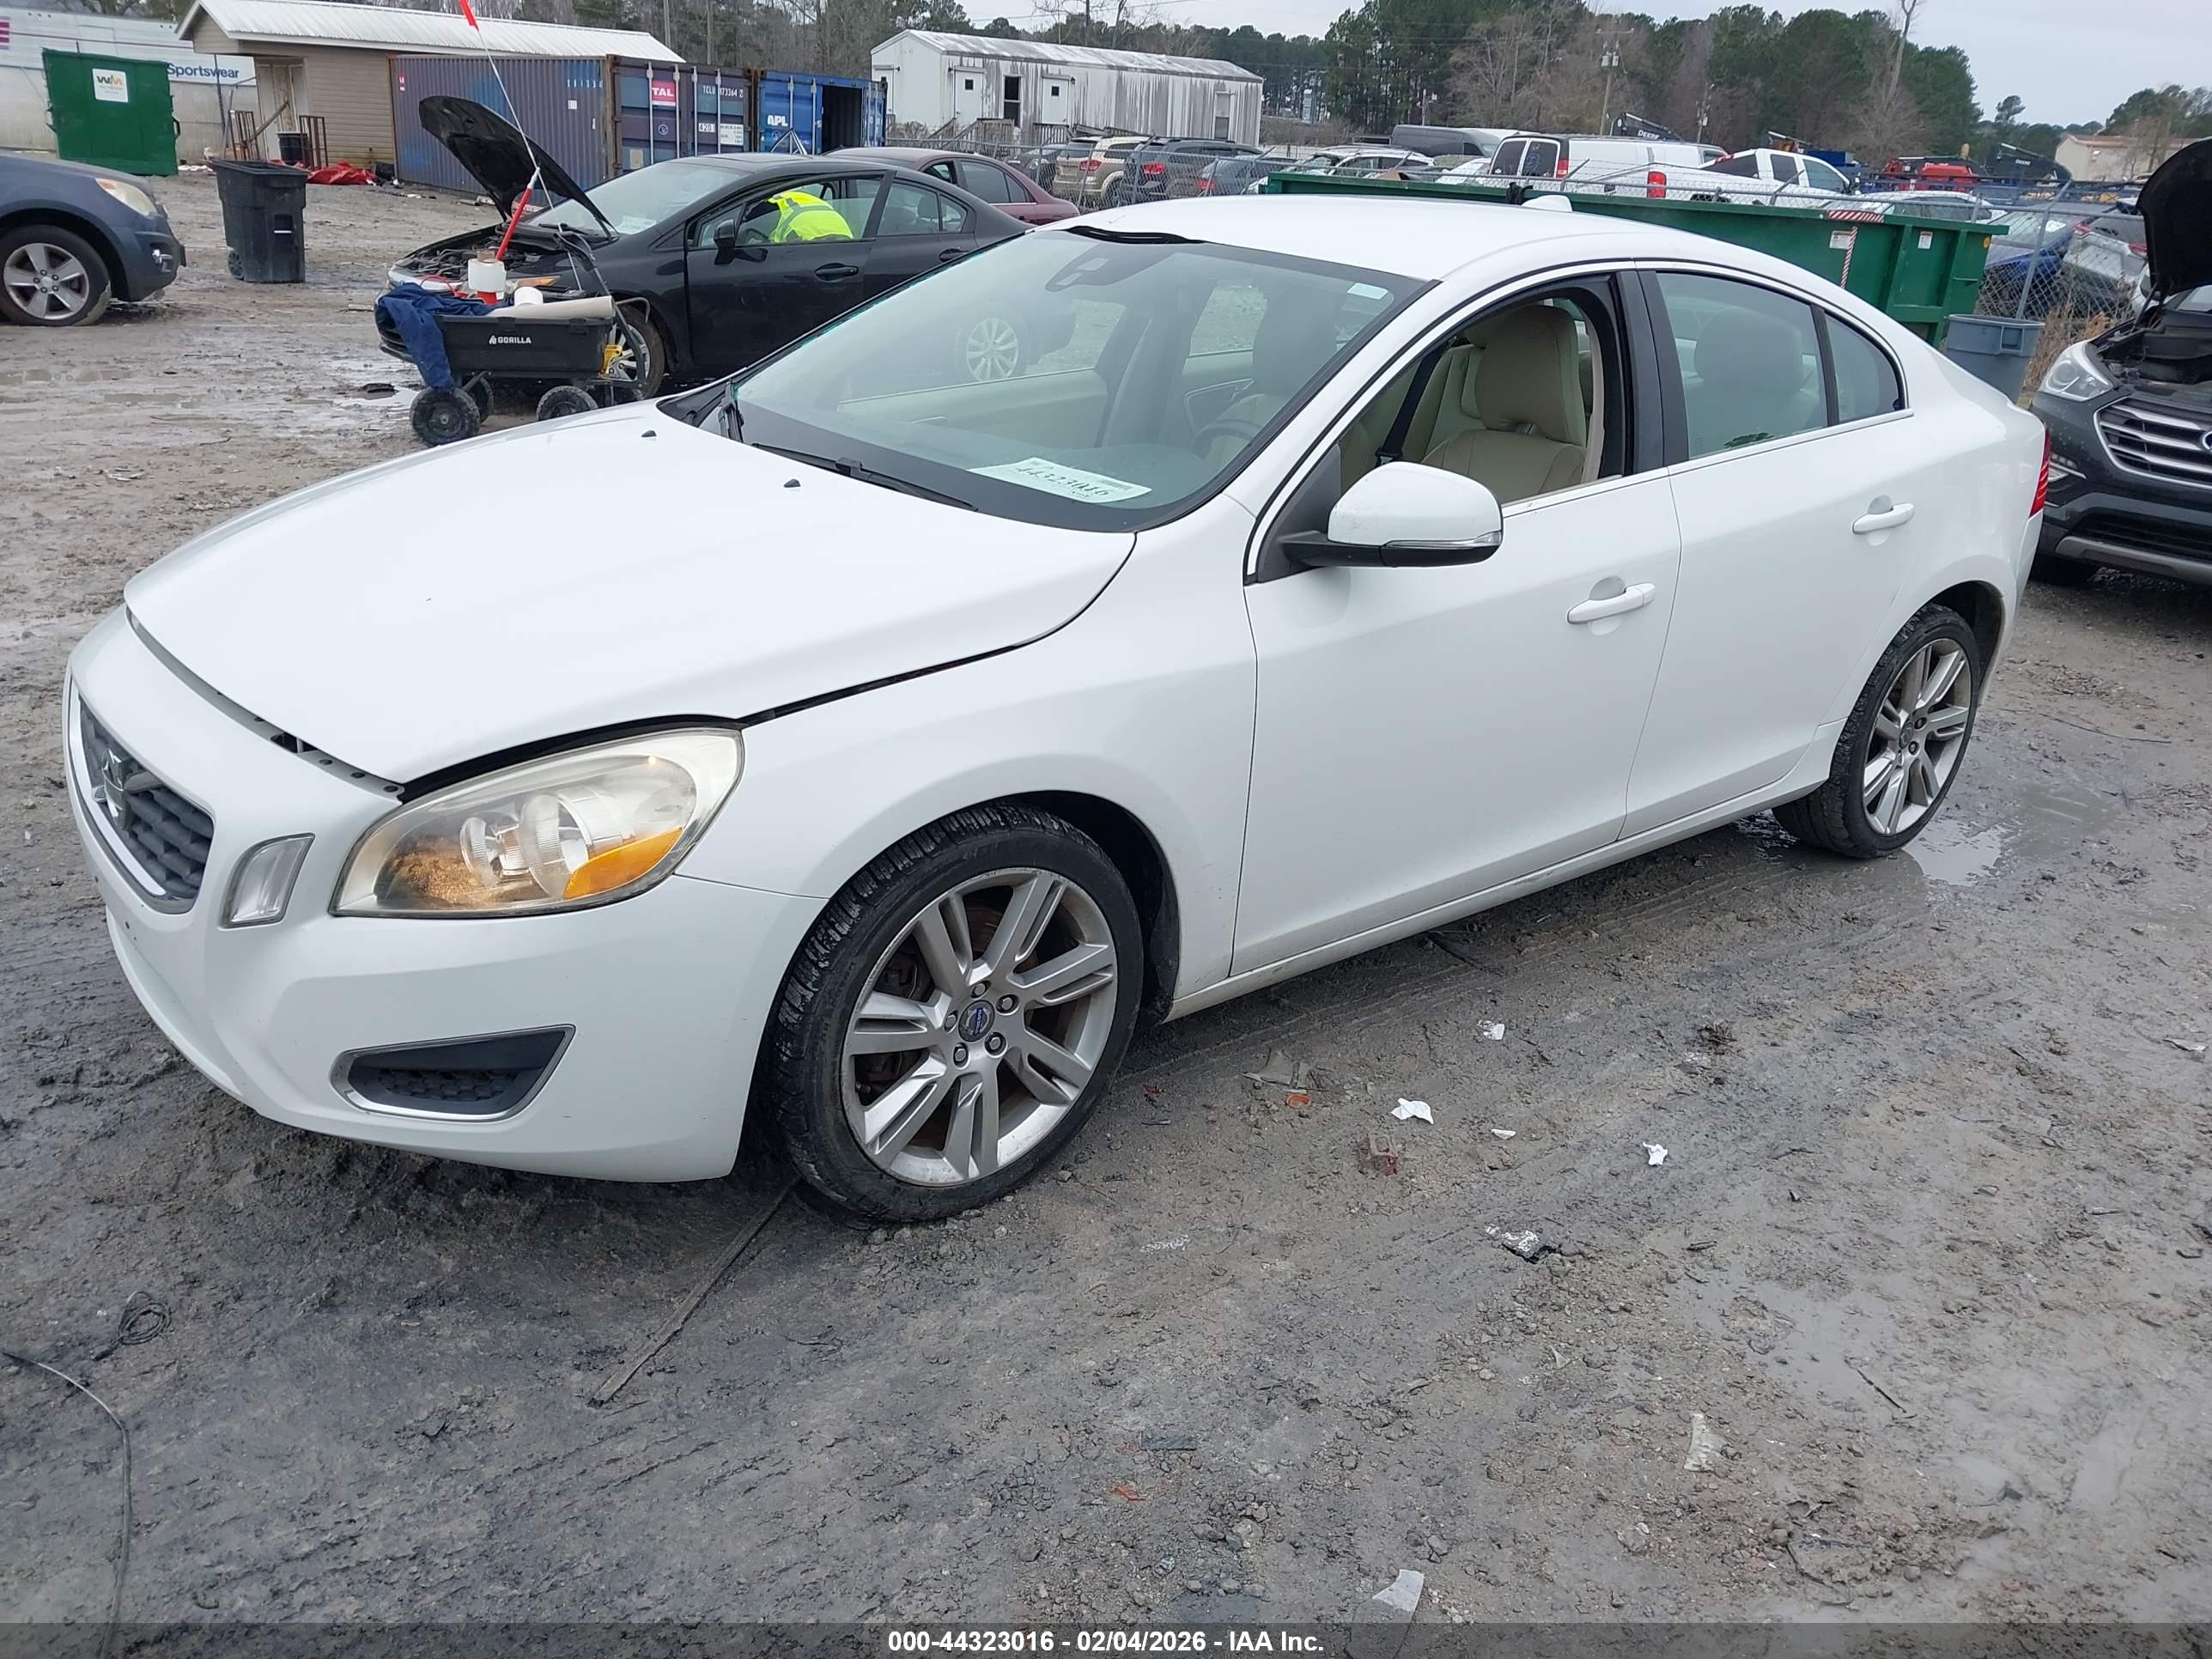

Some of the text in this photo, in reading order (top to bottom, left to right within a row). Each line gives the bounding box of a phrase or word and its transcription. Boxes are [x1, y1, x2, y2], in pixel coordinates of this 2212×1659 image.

[166, 63, 240, 78] Sportswear
[652, 87, 674, 97] TAL
[702, 85, 716, 94] TCLU
[767, 114, 788, 126] APL
[497, 336, 532, 344] GORILLA
